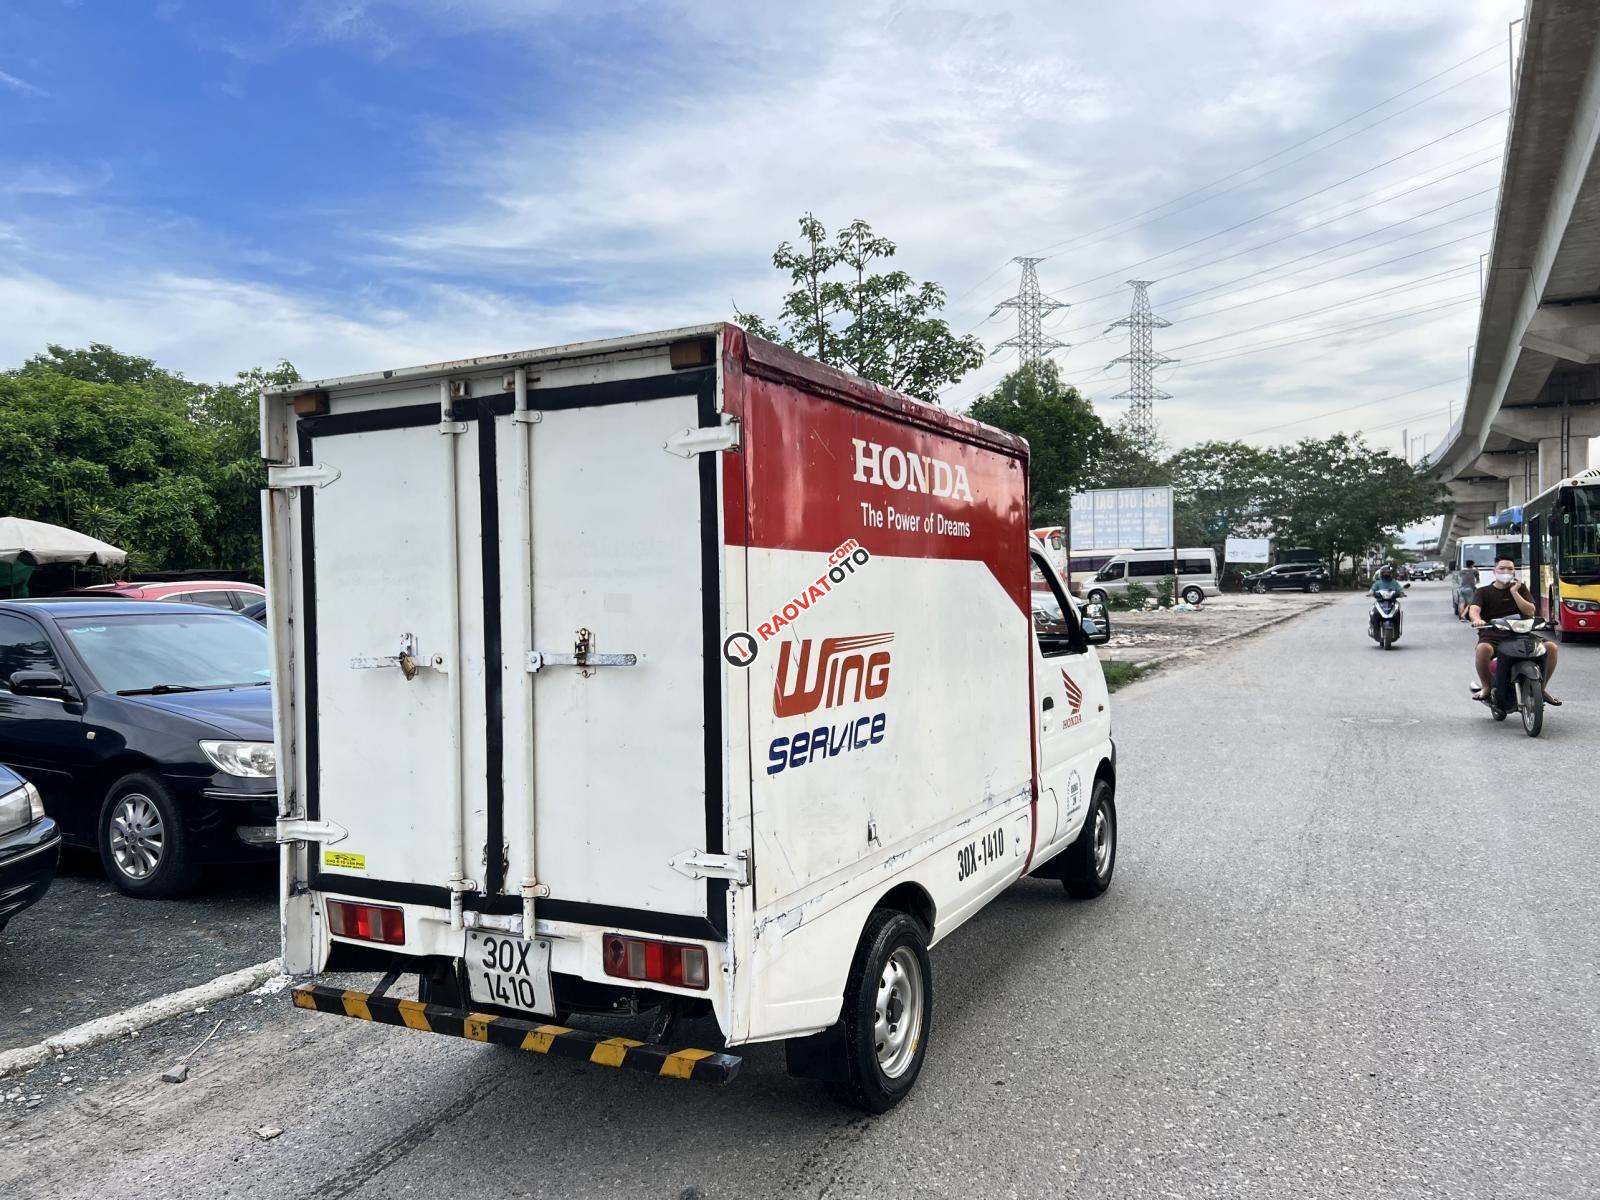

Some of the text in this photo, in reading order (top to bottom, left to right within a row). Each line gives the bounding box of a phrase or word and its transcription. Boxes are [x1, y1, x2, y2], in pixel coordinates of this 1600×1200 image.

[852, 438, 974, 502] HONDA
[860, 502, 971, 537] The Power of Dreams
[1062, 714, 1082, 730] HONDA
[957, 827, 1004, 882] 30X-1410
[482, 937, 531, 976] 30X
[484, 972, 535, 1008] 1410
